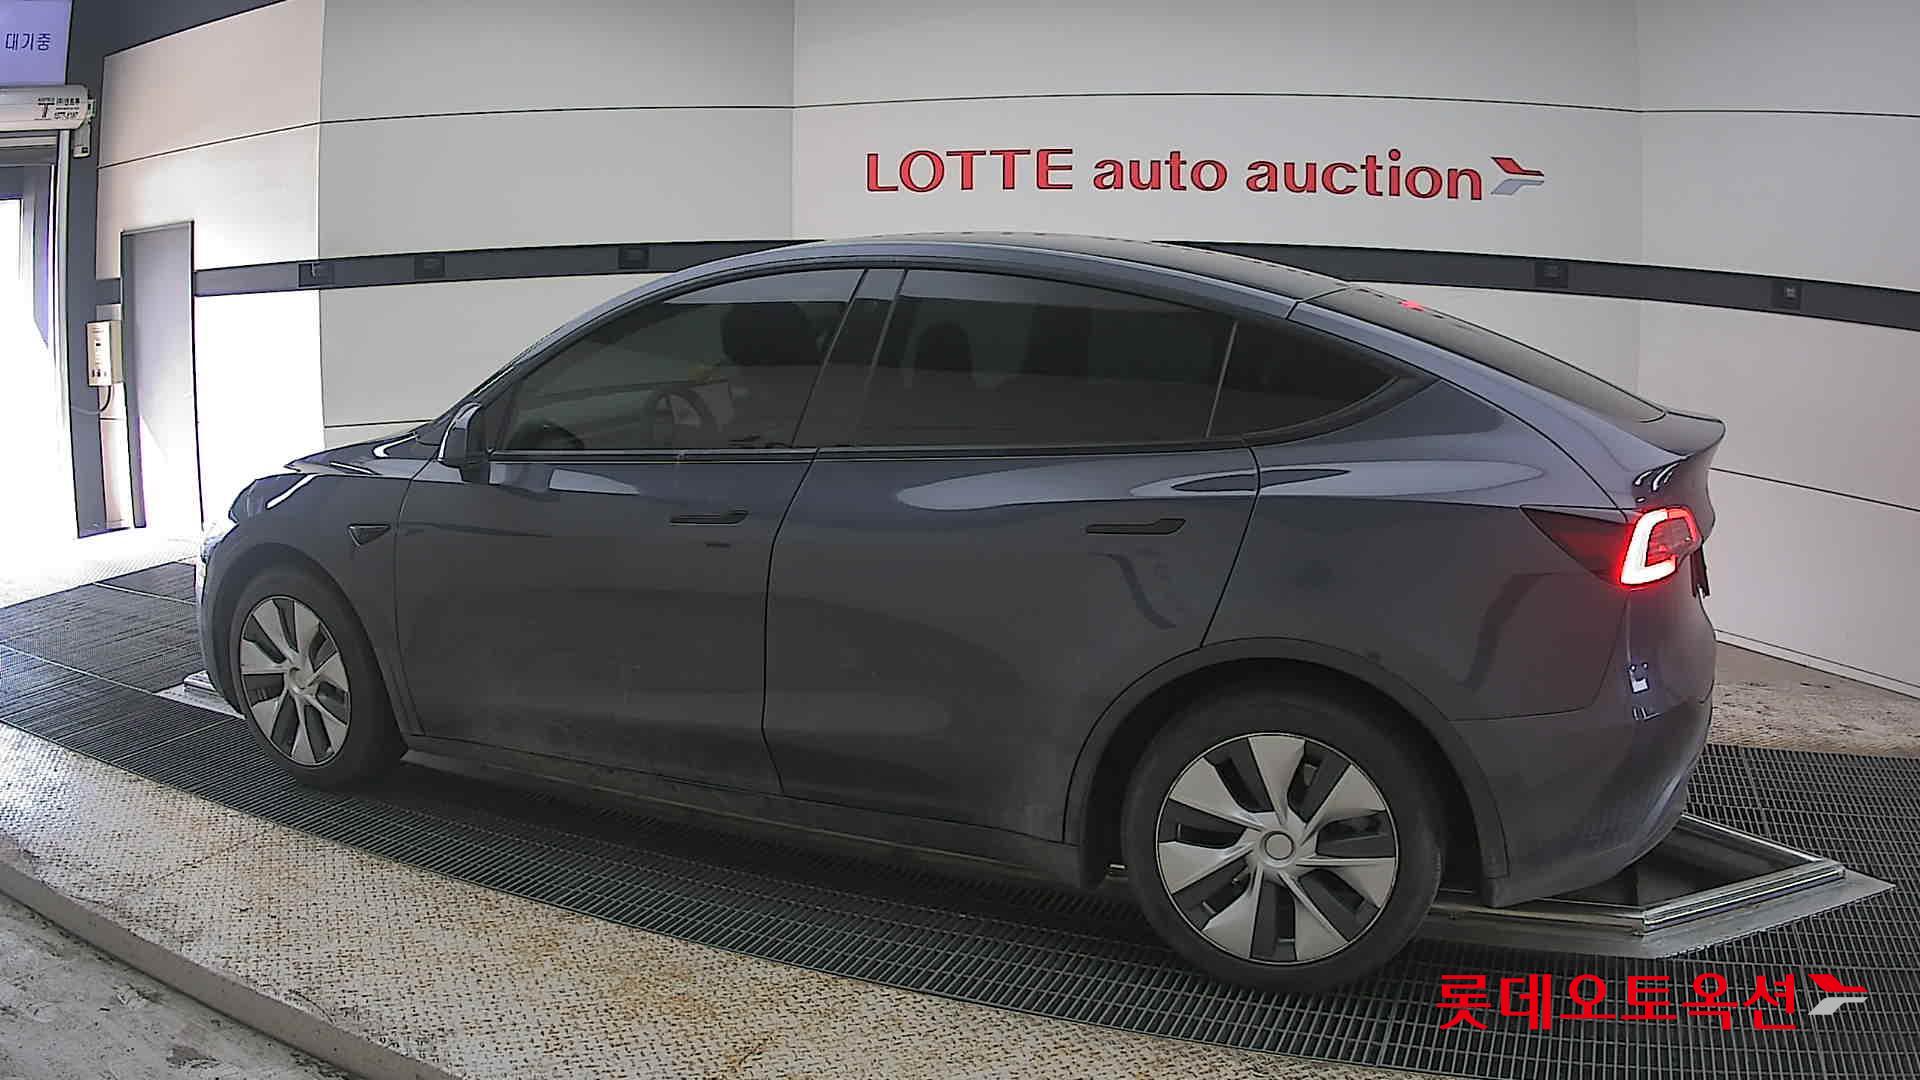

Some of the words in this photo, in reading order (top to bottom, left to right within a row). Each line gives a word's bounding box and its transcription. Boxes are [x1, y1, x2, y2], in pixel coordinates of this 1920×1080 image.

[5, 32, 51, 51] 대기중
[866, 148, 1074, 193] LOTTE
[1092, 150, 1228, 192] auto
[1246, 148, 1484, 200] auction
